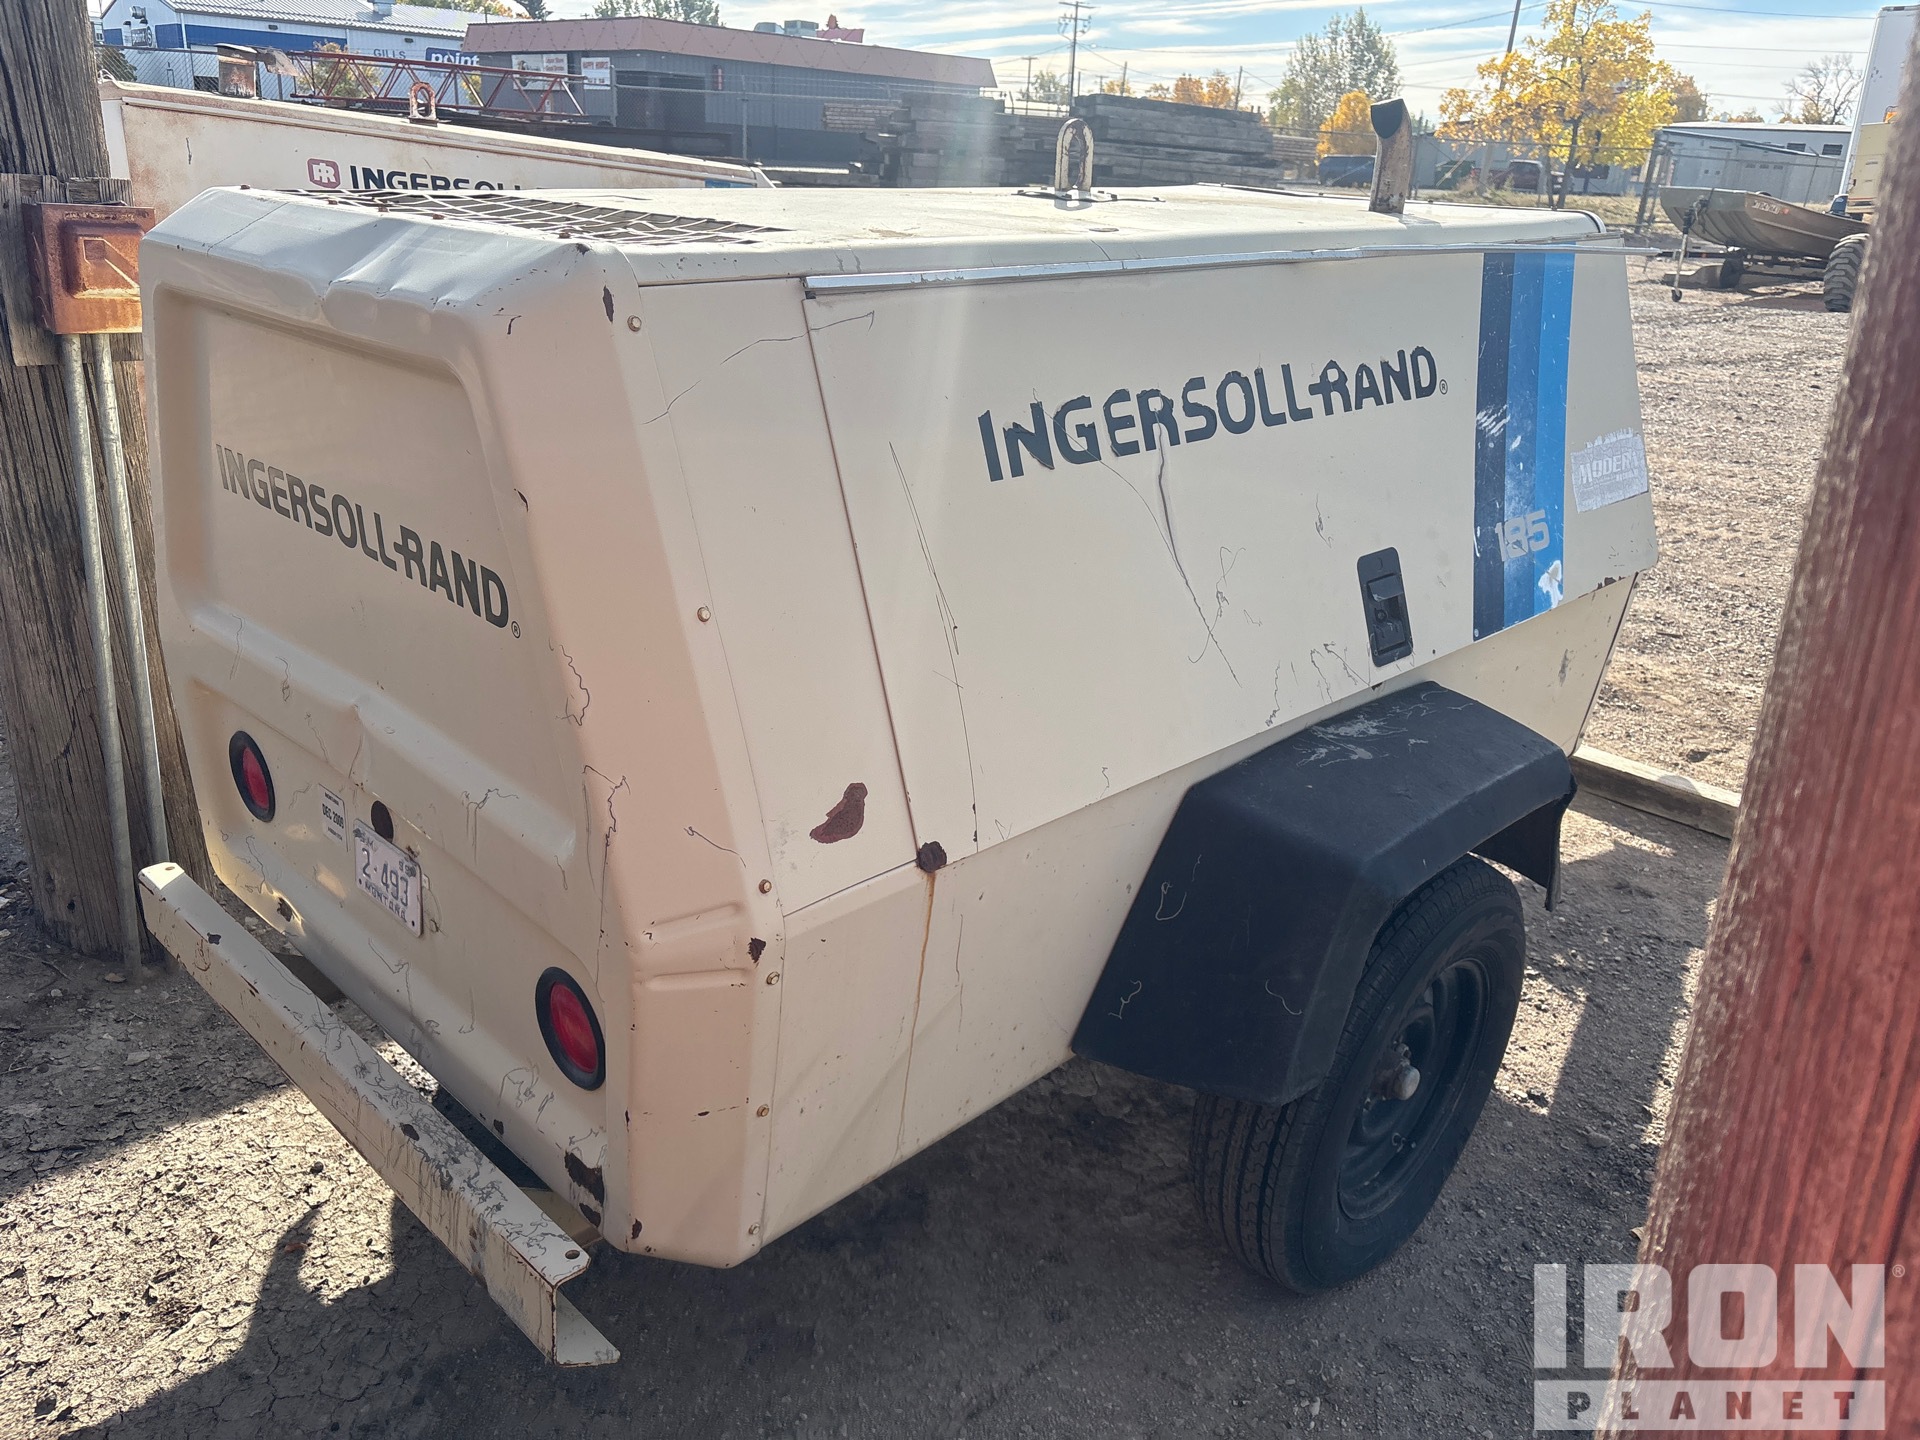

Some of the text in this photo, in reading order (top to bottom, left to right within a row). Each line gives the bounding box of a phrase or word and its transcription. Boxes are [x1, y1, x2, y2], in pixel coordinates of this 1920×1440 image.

[350, 165, 521, 190] INGERS
[1495, 509, 1550, 562] 185
[322, 803, 332, 820] DEC
[365, 880, 407, 922] MONTANA
